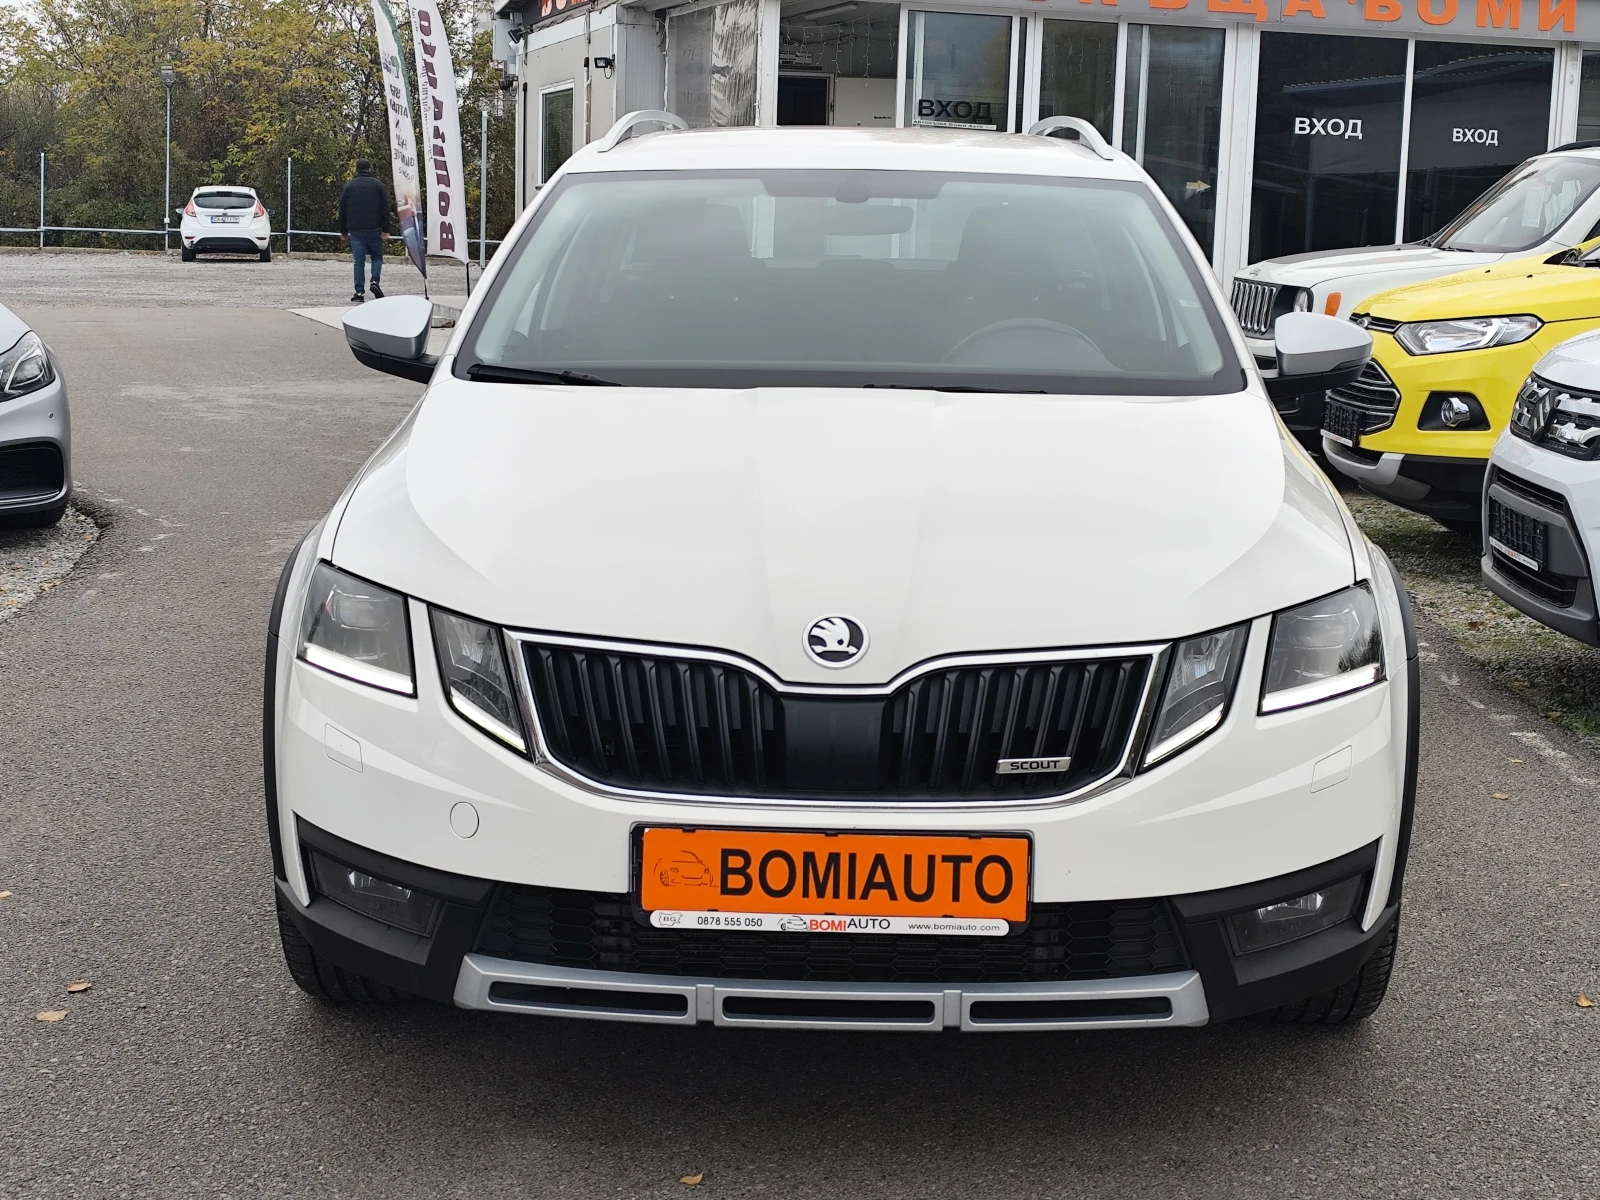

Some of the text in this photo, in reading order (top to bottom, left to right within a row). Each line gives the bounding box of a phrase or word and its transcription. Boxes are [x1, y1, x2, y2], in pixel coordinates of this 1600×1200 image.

[918, 99, 992, 124] ВХОД
[1294, 117, 1363, 140] ВХОД
[1452, 128, 1498, 146] ВХОД
[1010, 760, 1061, 771] SCOUT
[720, 848, 1013, 904] BOMIAUTO
[697, 916, 763, 927] 0878 555 050
[908, 923, 1000, 932] www.bomiauto.com
